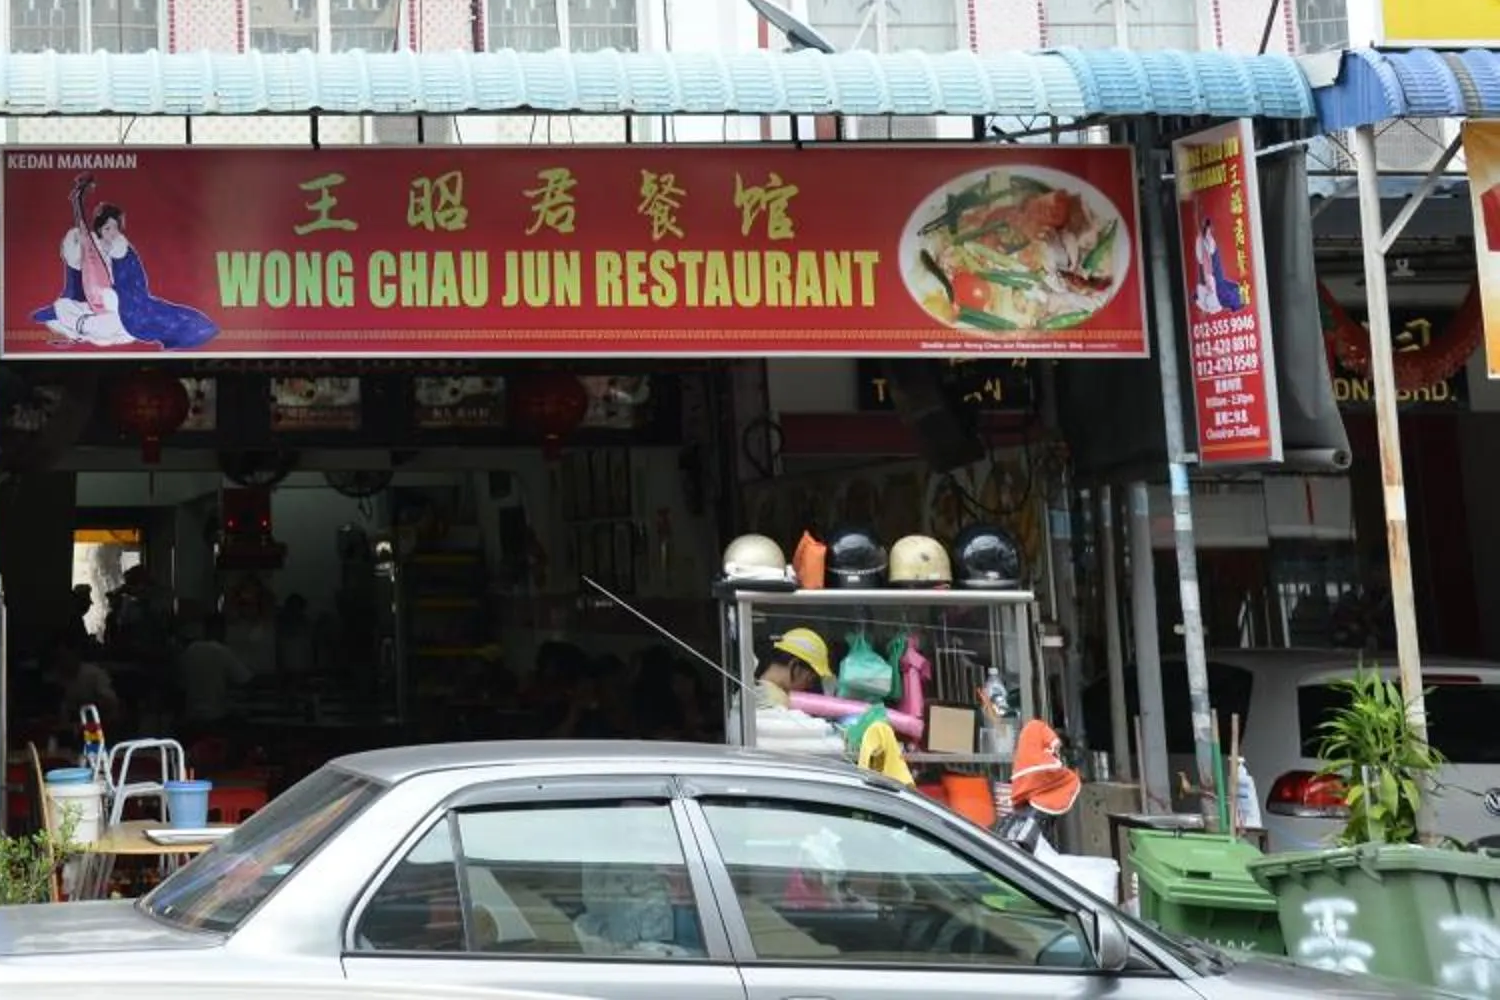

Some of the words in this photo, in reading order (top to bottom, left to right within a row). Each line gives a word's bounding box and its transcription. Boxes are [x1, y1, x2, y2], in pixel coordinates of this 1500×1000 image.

[7, 153, 53, 169] KEDAI
[57, 153, 137, 169] MAKANAN
[294, 168, 800, 241] 王昭君餐馆
[216, 250, 355, 308] WONG
[368, 250, 488, 308] CHAU
[502, 250, 581, 308] JUN
[596, 250, 880, 307] RESTAURANT
